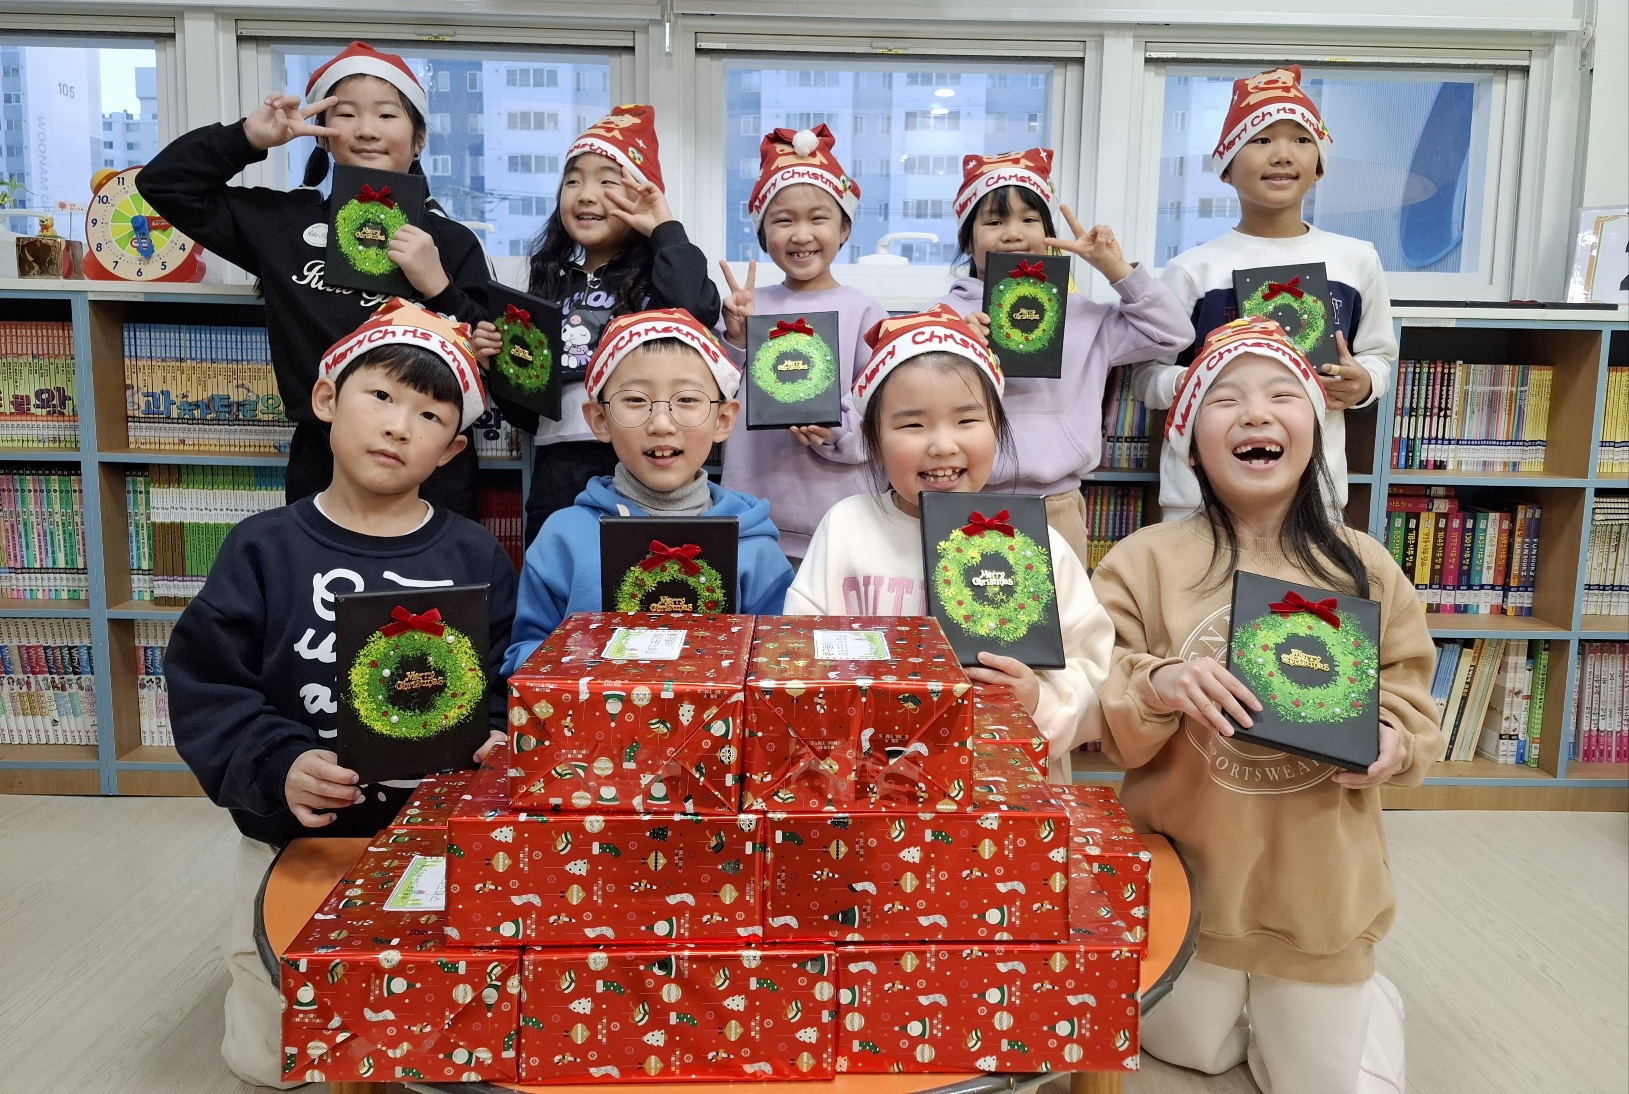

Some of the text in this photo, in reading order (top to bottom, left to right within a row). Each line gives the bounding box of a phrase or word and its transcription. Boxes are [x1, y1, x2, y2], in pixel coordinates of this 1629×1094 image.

[58, 82, 75, 99] 105
[1214, 123, 1247, 160] Merry
[37, 116, 49, 191] WOONAM
[117, 177, 125, 186] 11
[753, 169, 844, 215] Merry Christmas
[98, 195, 109, 204] 10
[91, 218, 98, 227] 9
[95, 243, 102, 252] 8
[179, 243, 186, 252] 4
[112, 261, 119, 270] 7
[160, 262, 167, 270] 5
[136, 267, 143, 277] 6
[615, 325, 720, 365] Christmas
[324, 334, 368, 375] Merry
[368, 328, 470, 393] Christmas
[857, 344, 896, 398] Merry
[1175, 341, 1311, 437] Merry Christmas
[1531, 538, 1539, 554] FUN
[980, 569, 1006, 579] Merry
[660, 595, 686, 605] Merry
[79, 647, 91, 672] Why?
[405, 670, 436, 681] Merry
